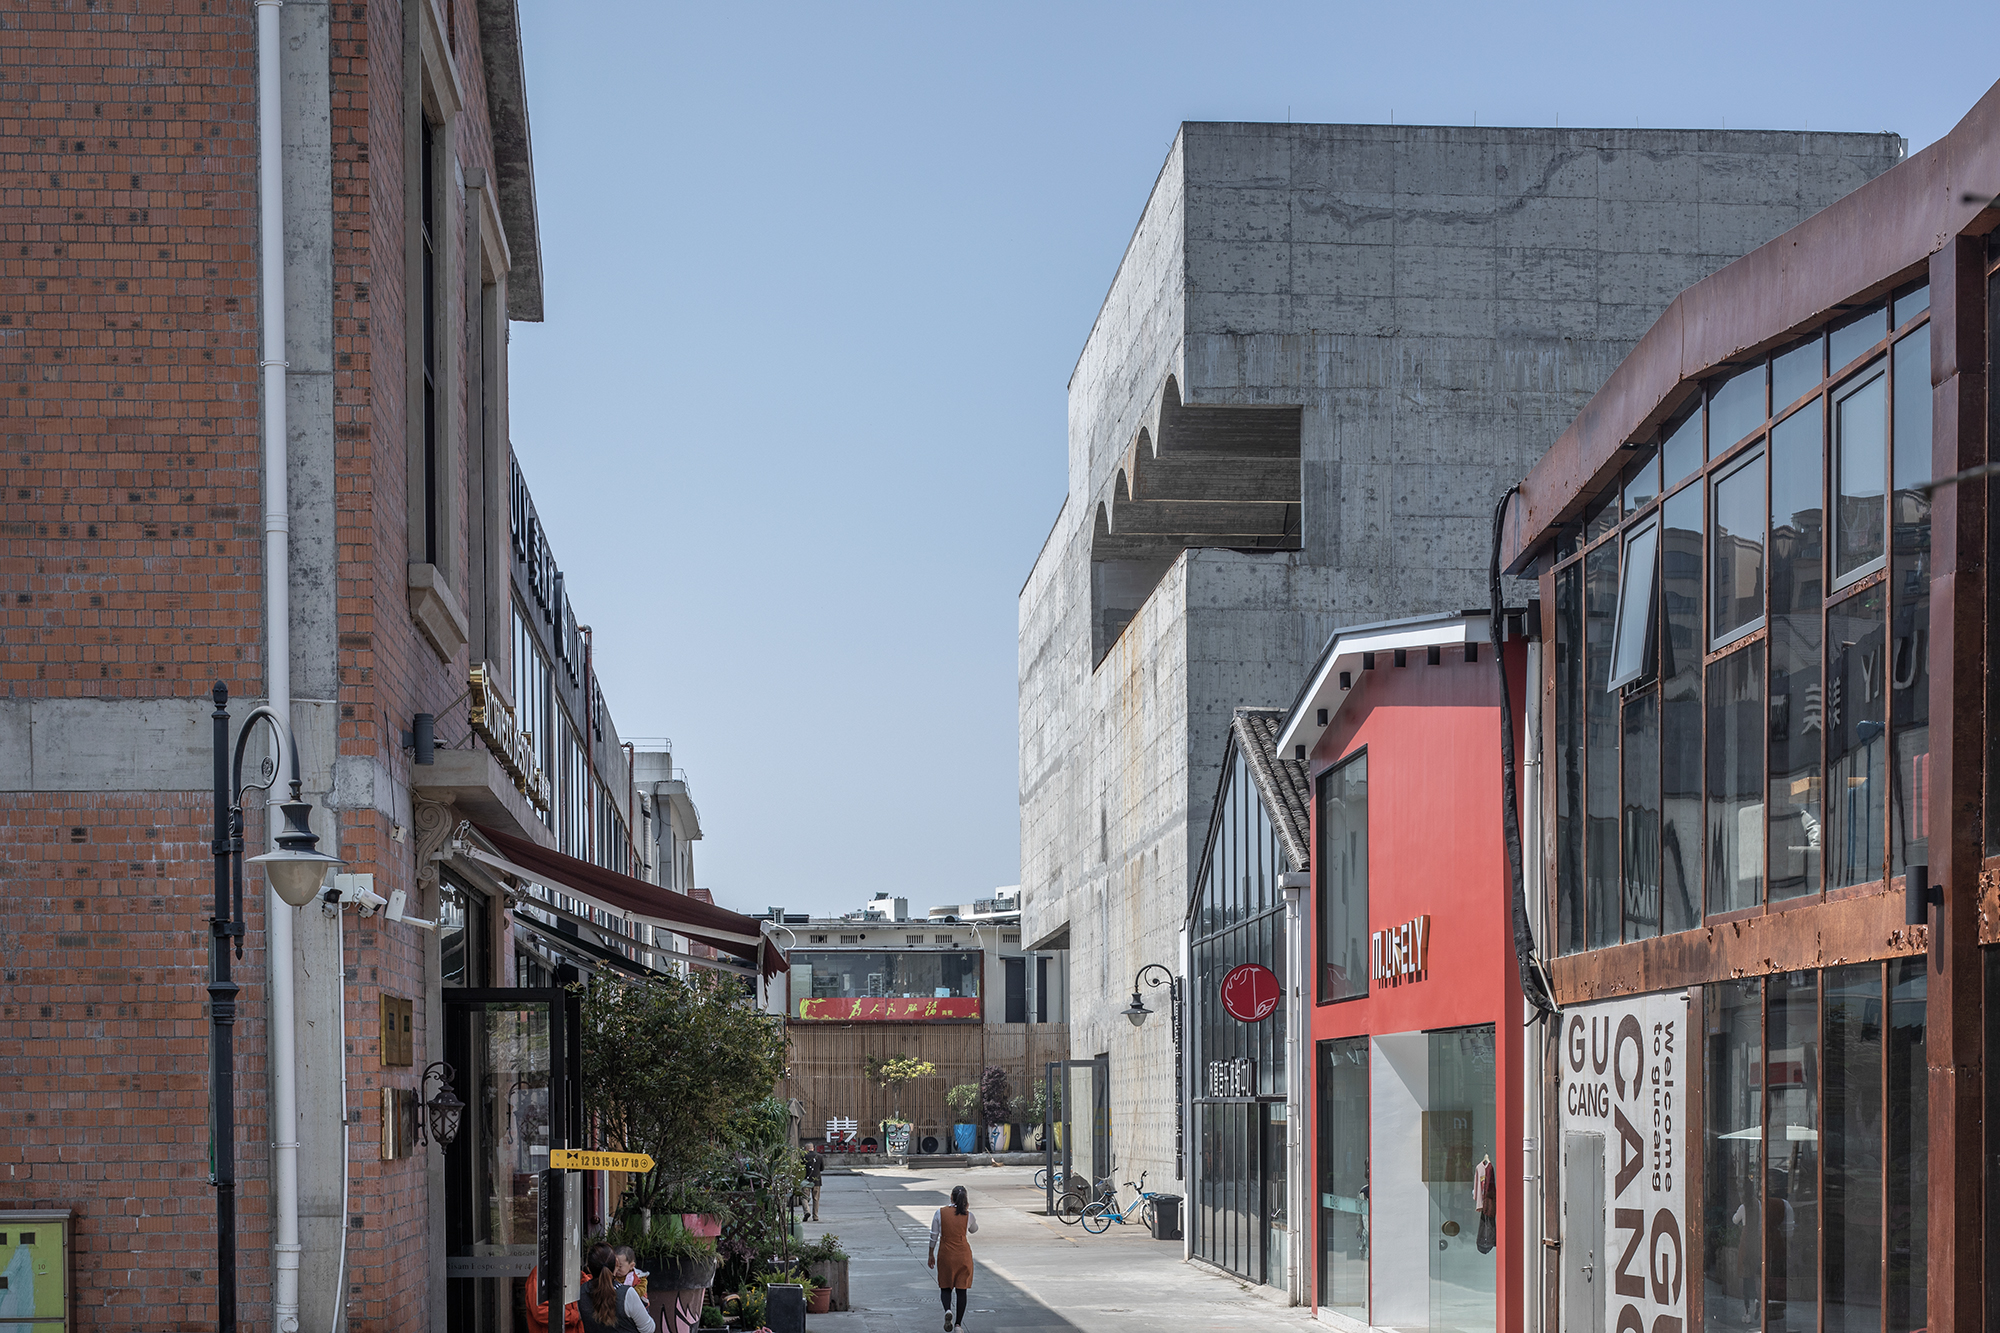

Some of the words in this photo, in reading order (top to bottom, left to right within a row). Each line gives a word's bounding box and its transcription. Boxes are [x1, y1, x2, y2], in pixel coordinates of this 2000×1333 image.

[1568, 1014, 1609, 1075] GU
[1652, 1022, 1663, 1056] to
[1568, 1082, 1609, 1118] CANG
[1651, 1066, 1662, 1192] gucang
[1663, 1020, 1674, 1193] welcome
[581, 1156, 589, 1166] 12
[592, 1156, 600, 1167] 13
[602, 1157, 610, 1167] 15
[612, 1157, 620, 1167] 16
[621, 1158, 629, 1168] 17
[631, 1158, 639, 1168] 18
[1650, 1207, 1683, 1333] G
